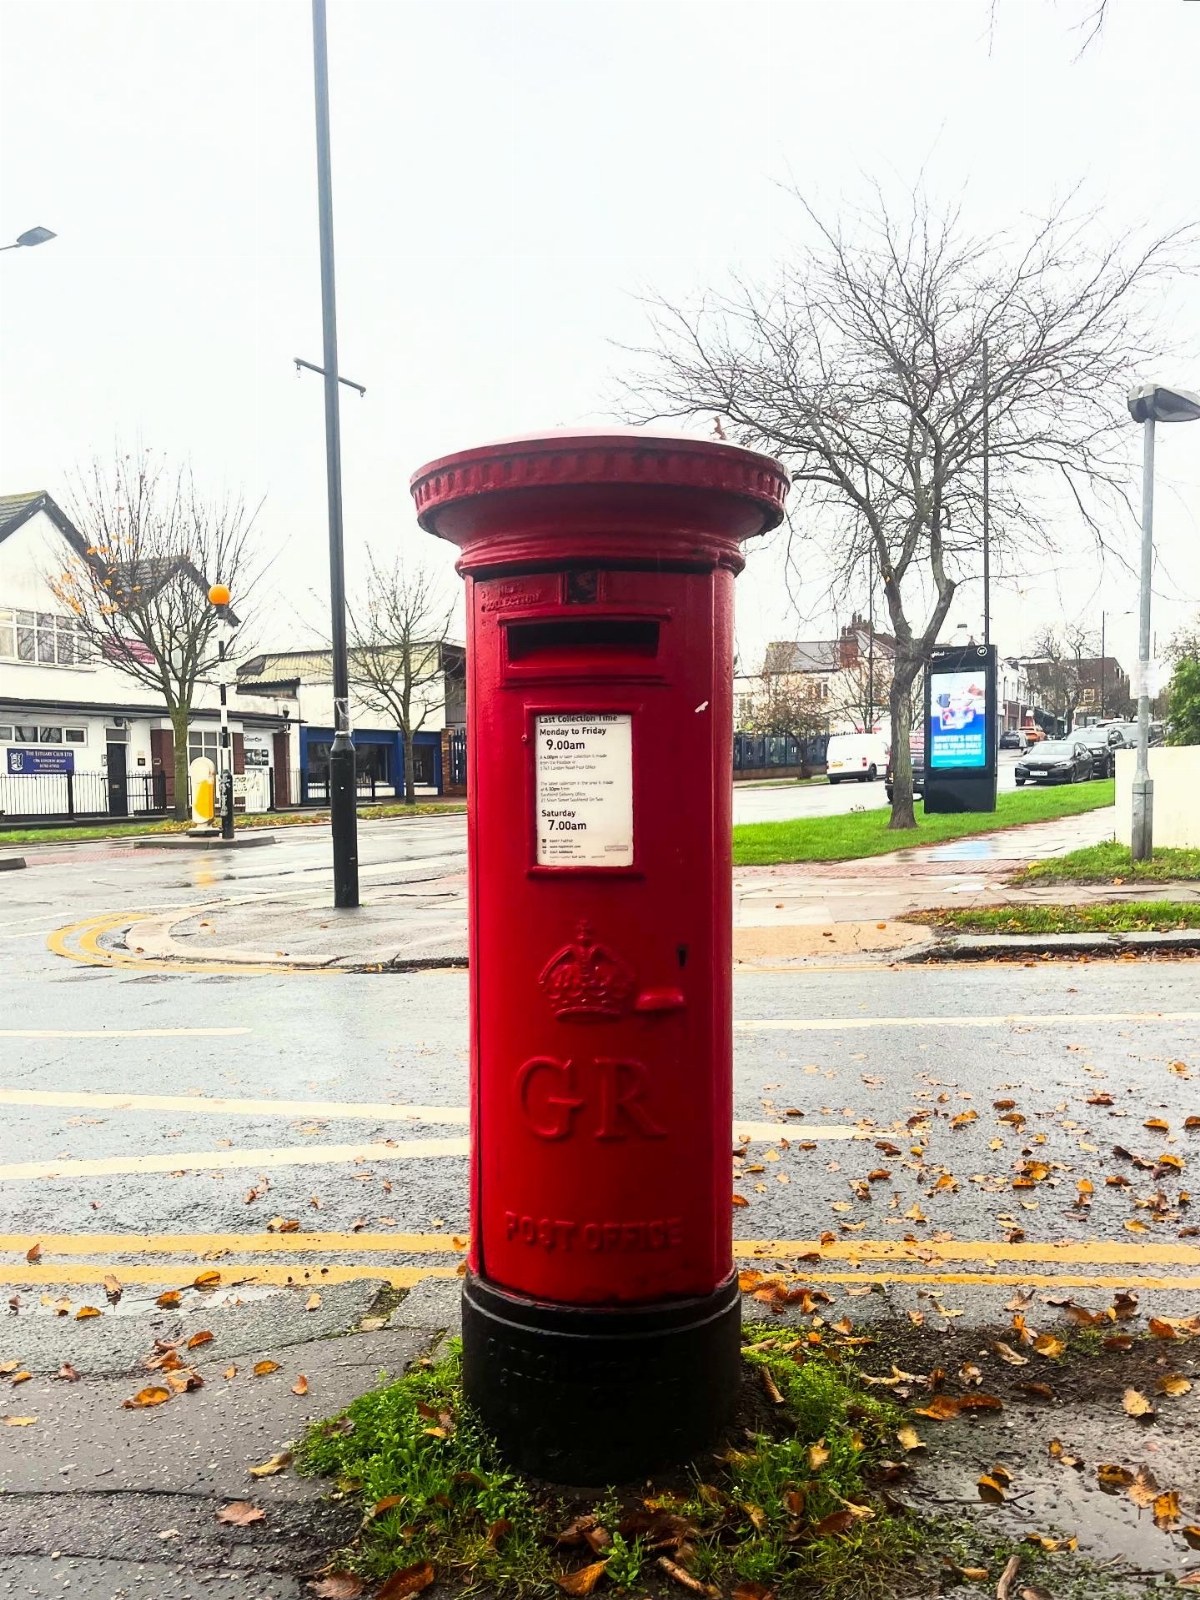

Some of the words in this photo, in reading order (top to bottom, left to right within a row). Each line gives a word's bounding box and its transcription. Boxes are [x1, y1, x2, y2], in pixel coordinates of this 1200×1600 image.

[539, 716, 556, 724] Last
[557, 715, 596, 723] Collection
[539, 728, 569, 737] Monday
[581, 726, 607, 736] Friday
[546, 739, 585, 750] 9.00am
[541, 809, 577, 818] Saturday
[547, 819, 587, 831] 7.00am
[515, 1054, 669, 1142] GR
[504, 1210, 577, 1254] POST
[583, 1217, 684, 1253] OFFICE
